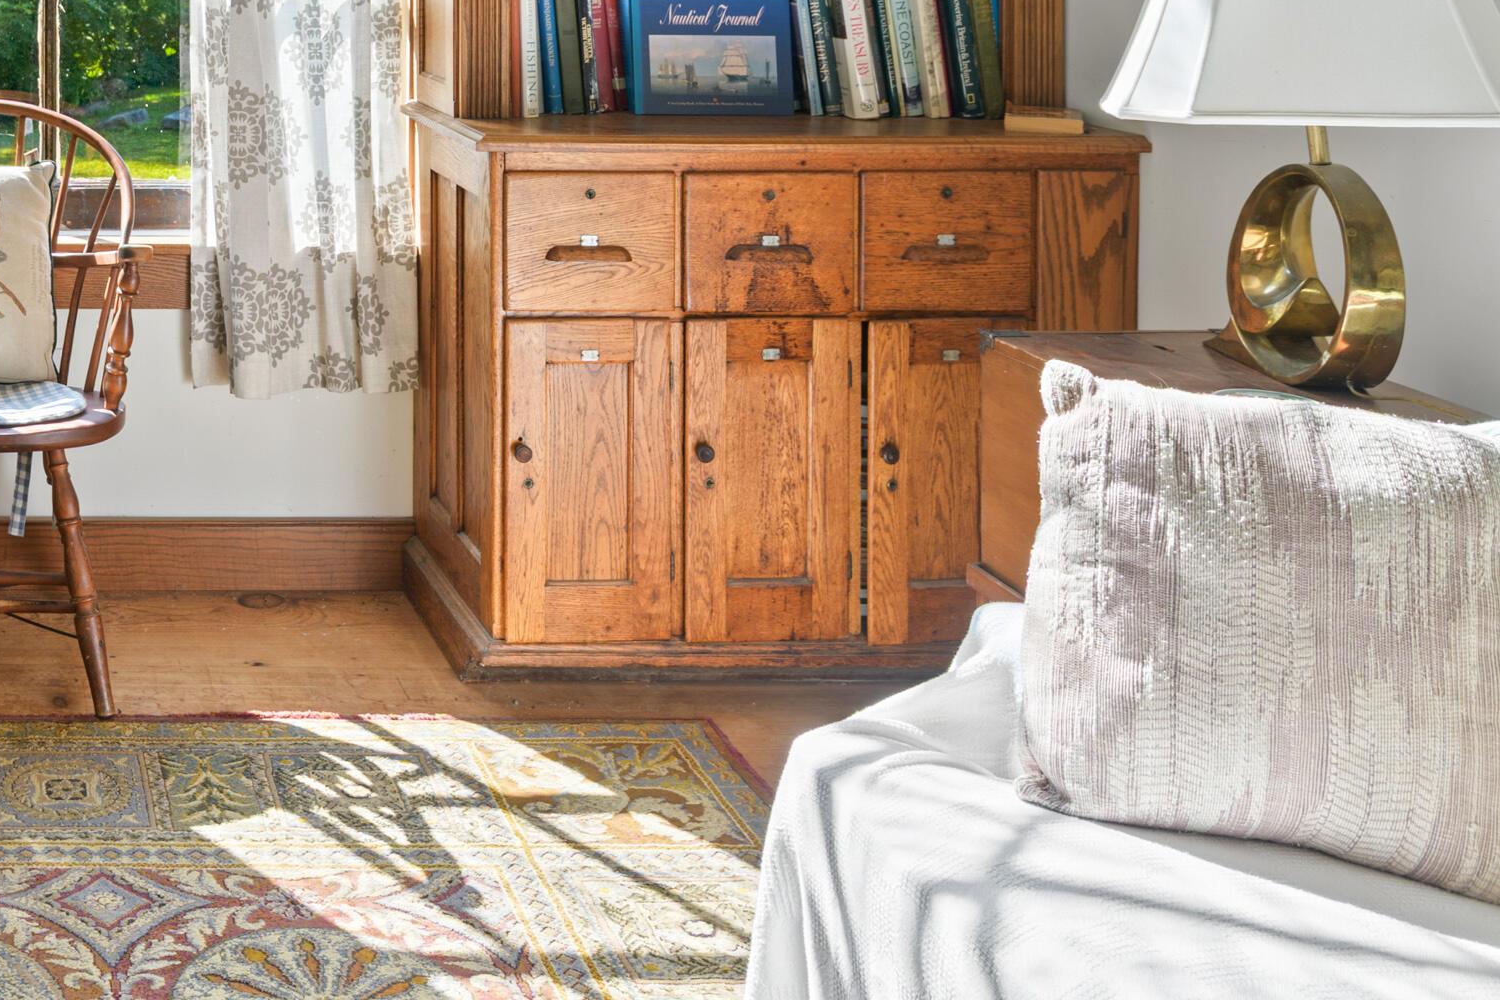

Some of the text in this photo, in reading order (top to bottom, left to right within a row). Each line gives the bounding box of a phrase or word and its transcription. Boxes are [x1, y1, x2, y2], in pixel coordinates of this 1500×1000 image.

[660, 3, 765, 32] Nautical Journal
[546, 33, 555, 67] FRANKLIN
[582, 41, 590, 63] GARDEN
[815, 40, 830, 83] HOUSES
[850, 15, 870, 78] TREASURY
[884, 42, 891, 51] IN
[898, 22, 914, 66] COAST
[956, 27, 967, 53] Britain
[962, 60, 973, 87] Ireland
[527, 41, 538, 103] FISHING
[885, 53, 897, 89] AMERICA
